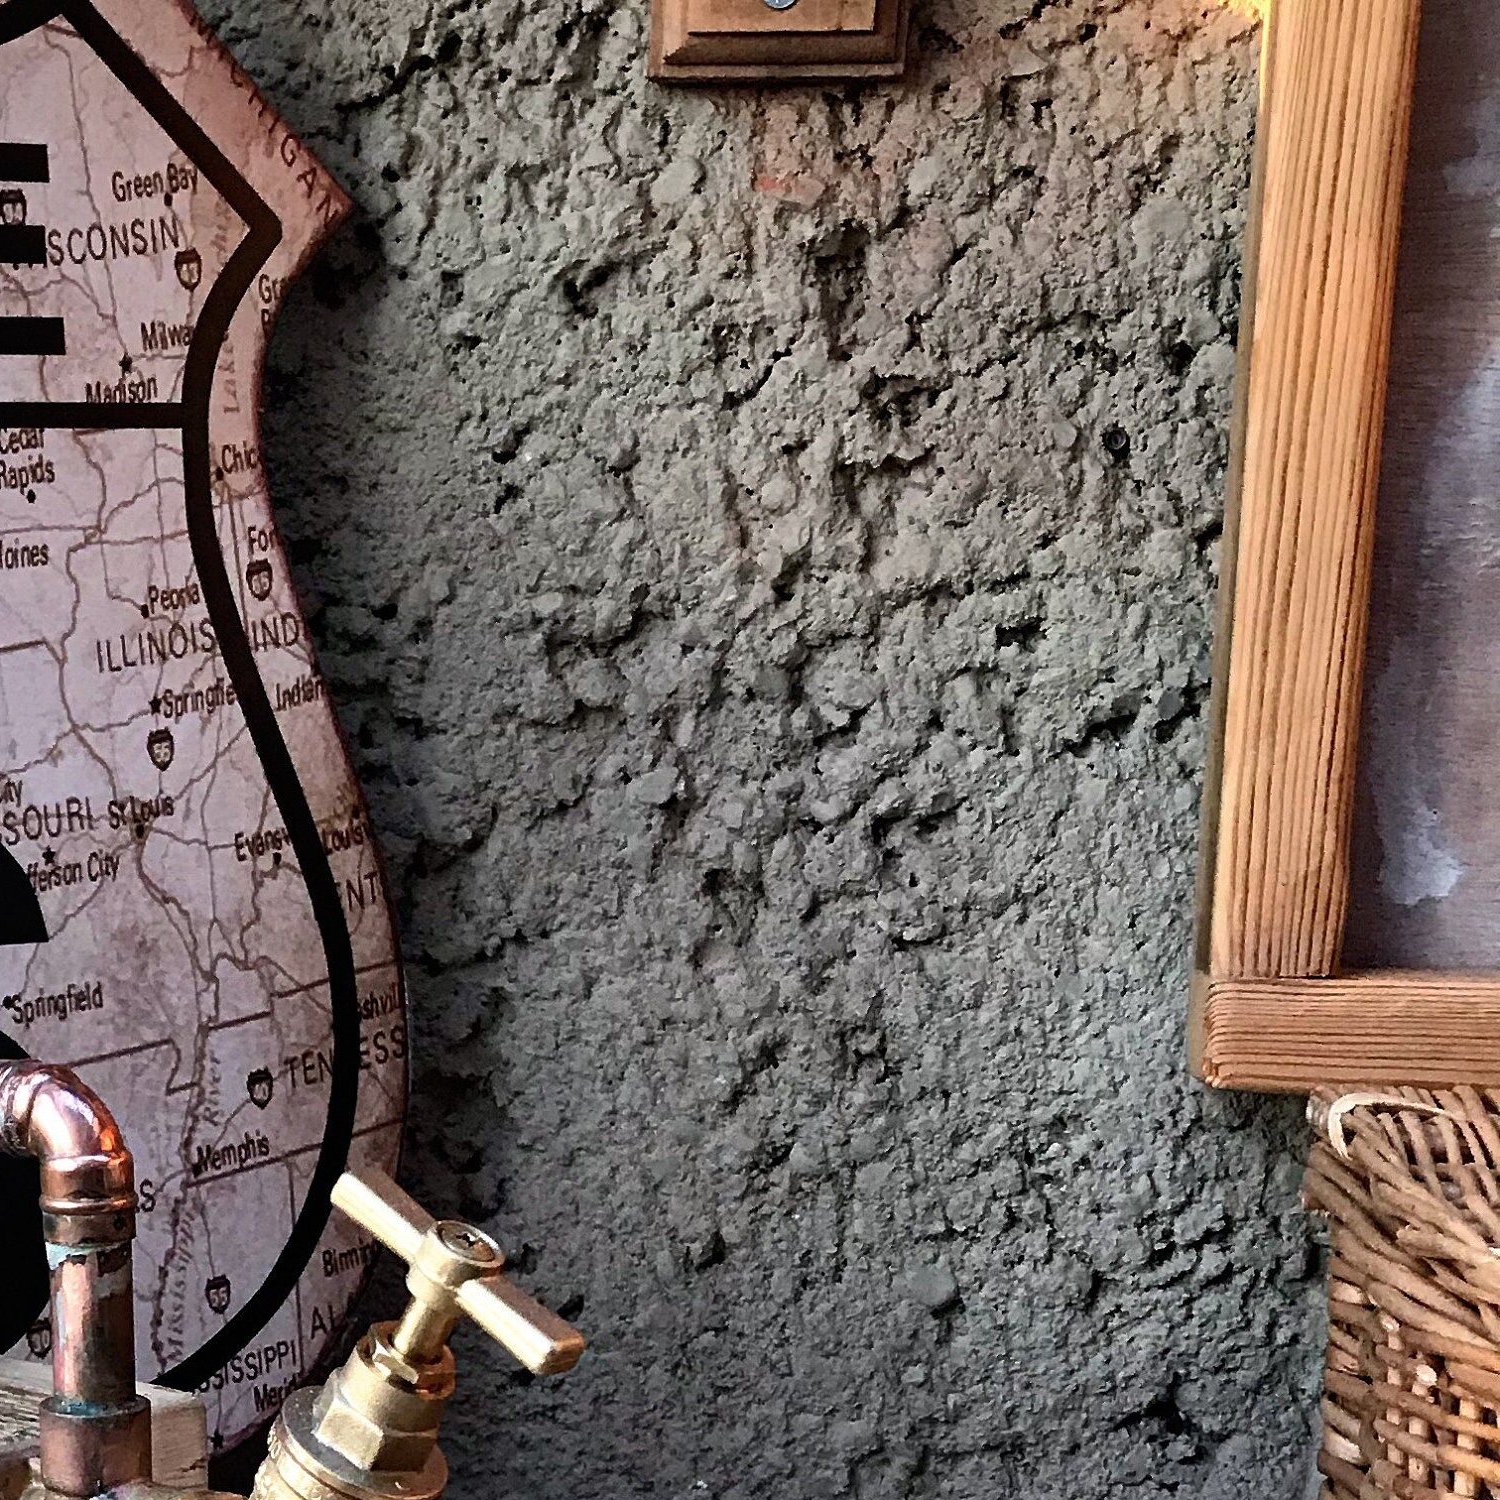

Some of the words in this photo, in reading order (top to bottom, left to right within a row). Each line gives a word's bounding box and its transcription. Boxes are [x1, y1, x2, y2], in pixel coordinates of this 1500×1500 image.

[111, 170, 164, 203] Green
[165, 161, 199, 199] Bay
[46, 214, 181, 267] SCONSIN
[140, 320, 195, 352] Milwa
[85, 375, 159, 404] Madison
[221, 441, 260, 475] Chic
[148, 583, 200, 614] Peoria
[96, 616, 219, 673] ILLINOIS
[162, 677, 238, 719] Springfie
[108, 799, 127, 831] St
[129, 793, 175, 825] Louis
[27, 860, 83, 894] fferson
[86, 851, 121, 883] City
[10, 981, 105, 1031] Springfield
[197, 1131, 271, 1173] Memphis
[253, 1372, 301, 1413] Merid
